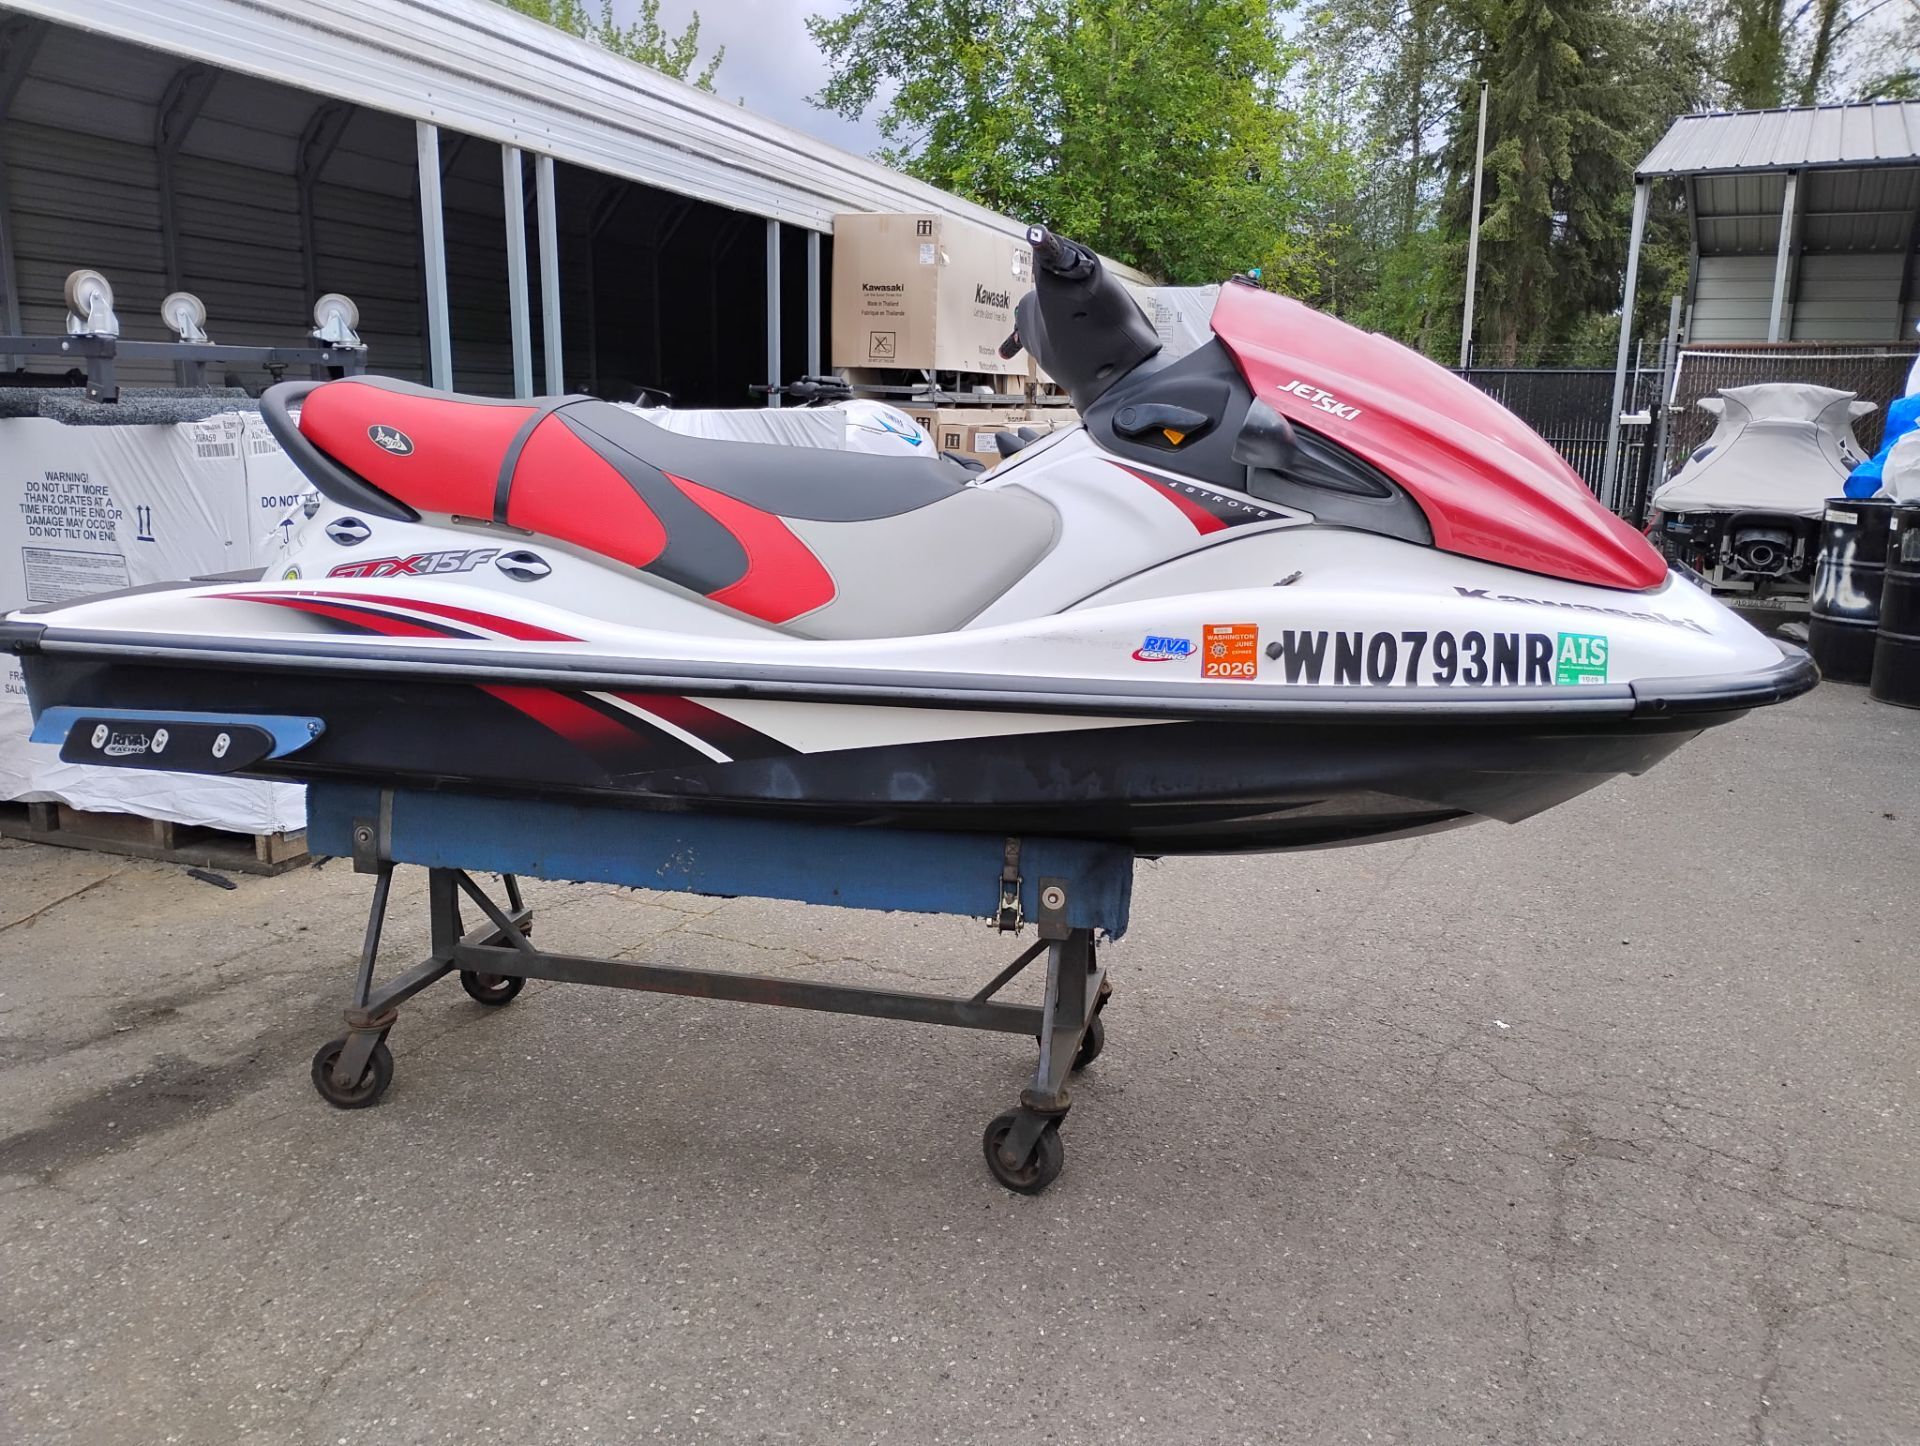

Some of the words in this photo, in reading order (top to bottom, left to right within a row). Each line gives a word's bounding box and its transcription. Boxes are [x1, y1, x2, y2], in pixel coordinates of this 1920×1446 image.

[862, 283, 904, 292] Kawasaki
[975, 283, 1011, 309] Kawasaki
[44, 471, 89, 483] WARNING!
[26, 482, 40, 492] DO
[42, 483, 60, 493] NOT
[62, 484, 80, 494] LIFT
[82, 485, 109, 496] MORE
[24, 493, 49, 503] THAN
[50, 494, 56, 504] 2
[57, 495, 92, 506] CRATES
[94, 497, 103, 507] AT
[105, 498, 114, 508] A
[261, 496, 277, 508] DO
[279, 494, 299, 507] NOT
[1185, 486, 1269, 518] STROKE
[19, 503, 40, 514] TIME
[42, 505, 67, 516] FROM
[69, 506, 87, 517] THE
[89, 507, 106, 518] END
[107, 509, 123, 520] OR
[26, 515, 64, 527] DAMAGE
[66, 518, 84, 528] MAY
[86, 519, 116, 531] OCCUR
[29, 526, 42, 536] DO
[44, 528, 62, 538] NOT
[64, 529, 81, 539] TILT
[83, 530, 97, 540] ON
[98, 531, 116, 542] END
[1143, 636, 1191, 654] RIVA
[1559, 637, 1606, 666] AIS
[1139, 650, 1187, 661] RACING
[1207, 662, 1255, 676] 2026
[110, 732, 146, 748] RIVA
